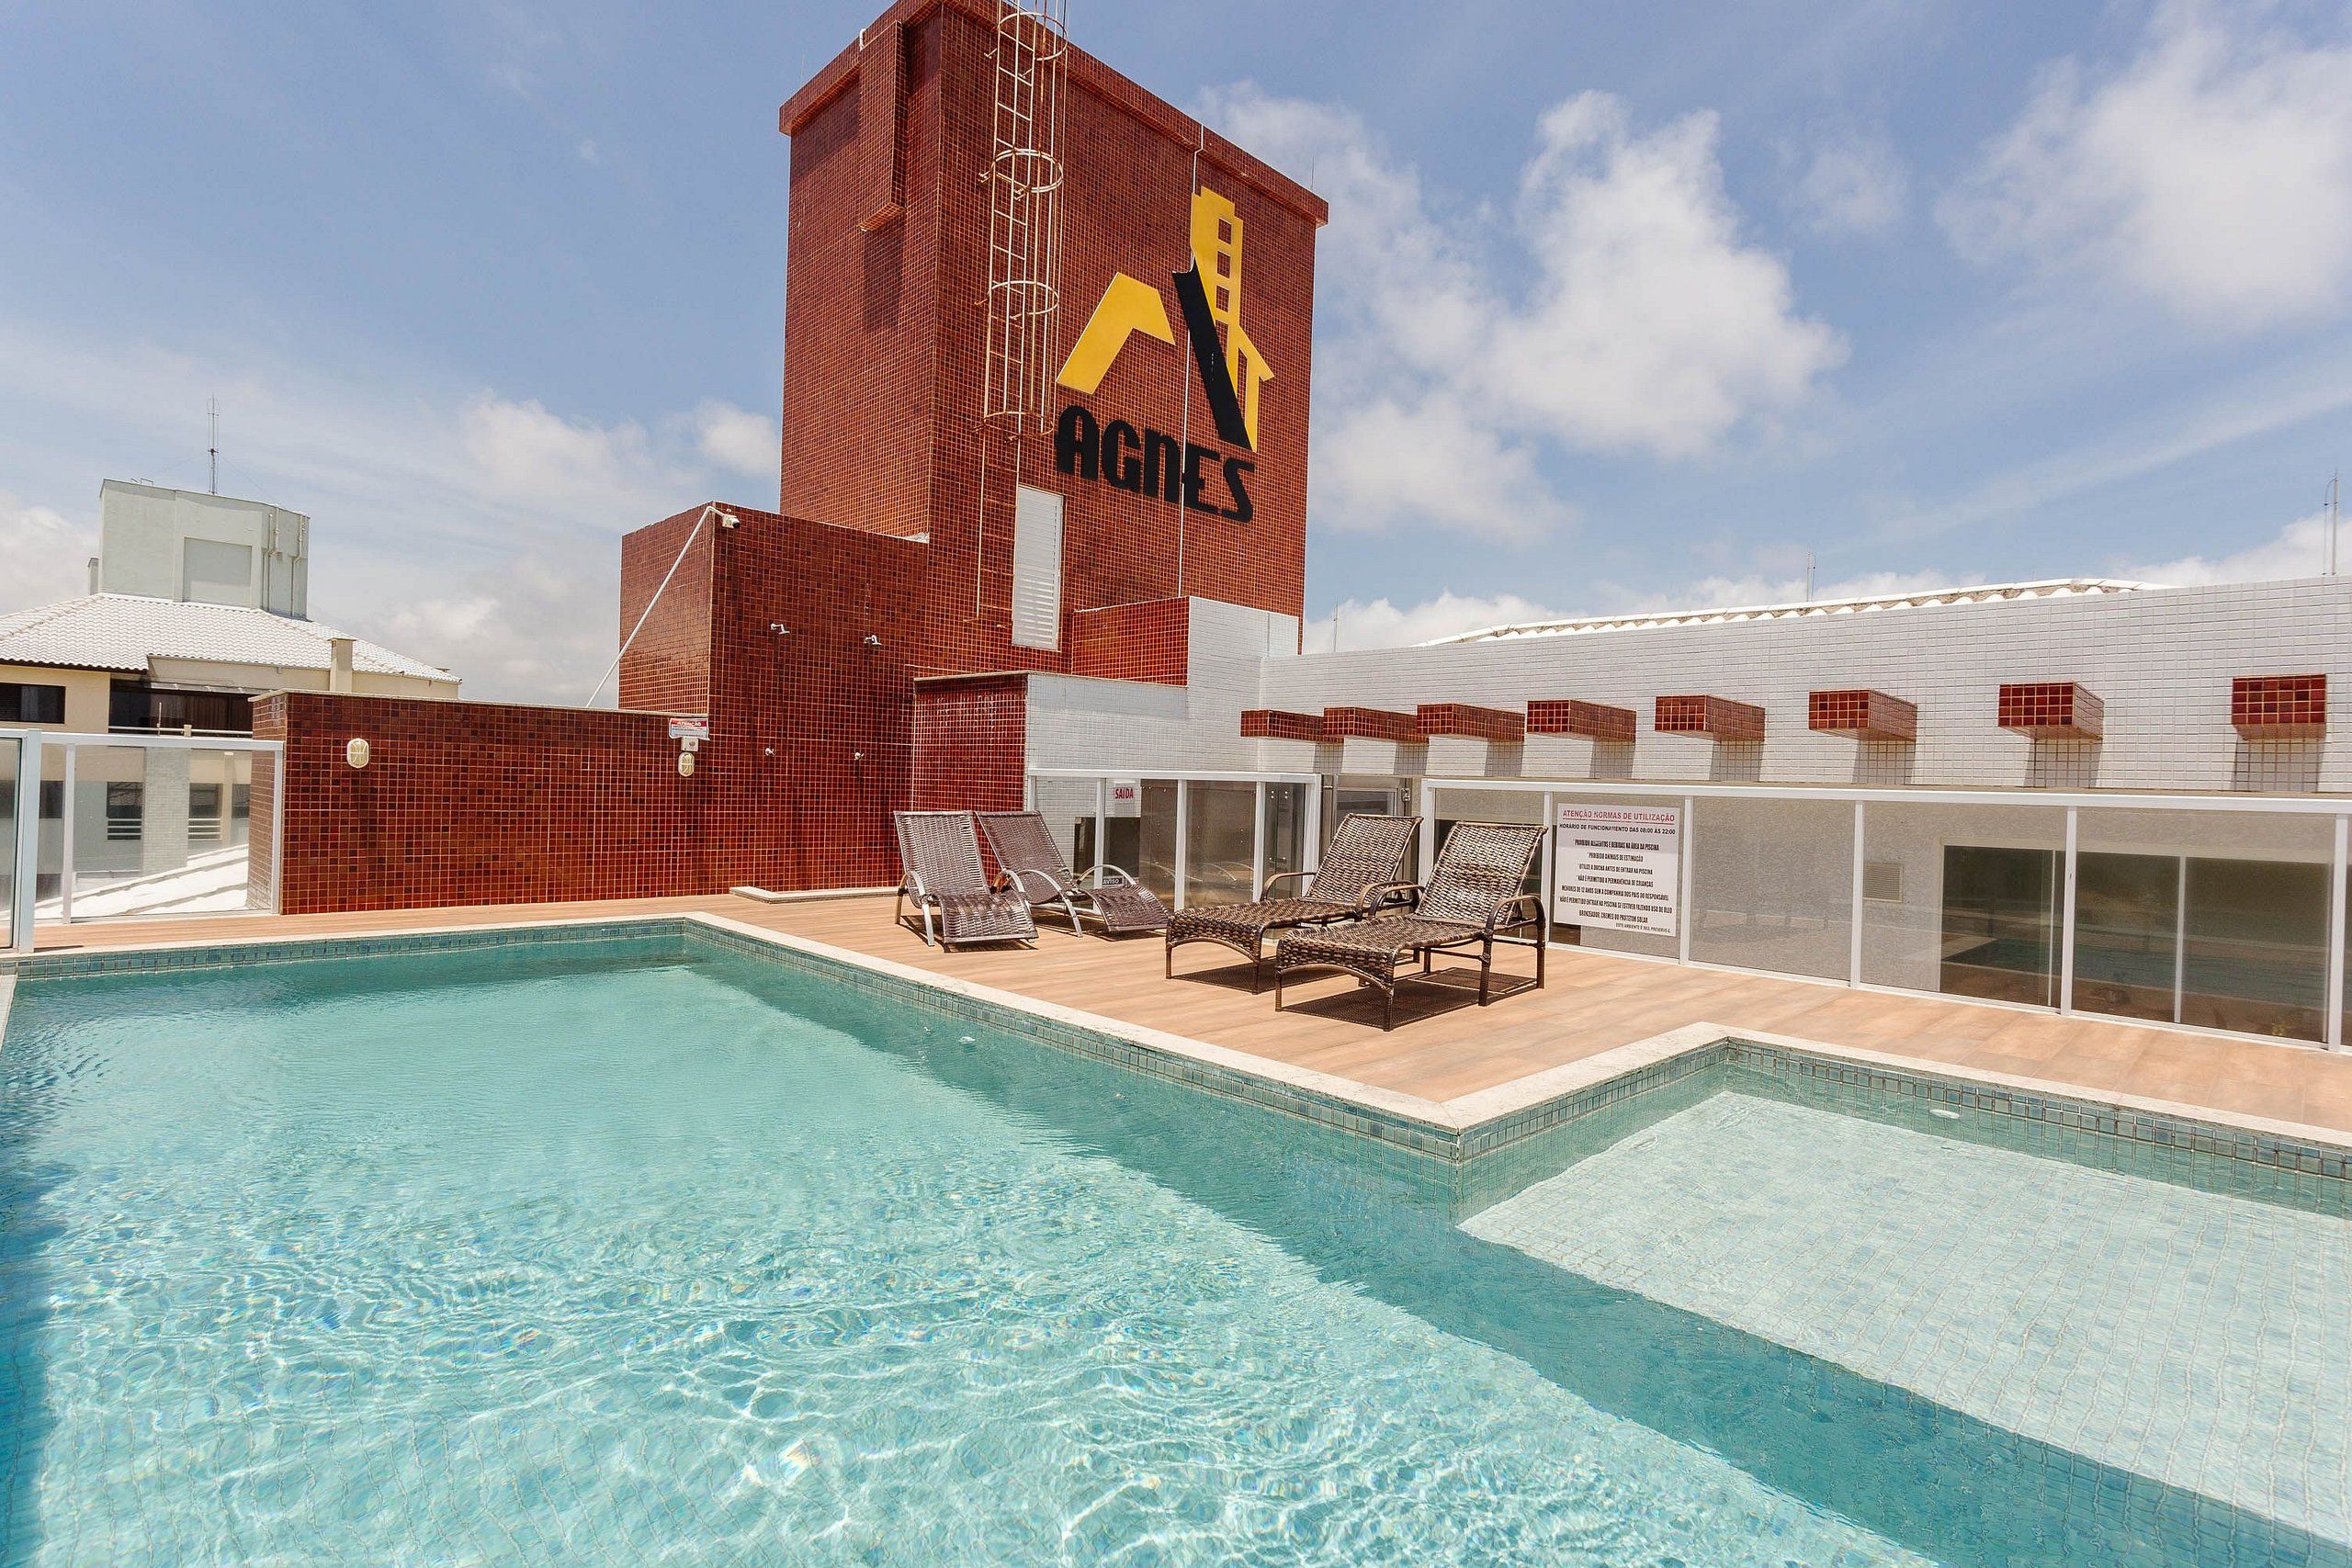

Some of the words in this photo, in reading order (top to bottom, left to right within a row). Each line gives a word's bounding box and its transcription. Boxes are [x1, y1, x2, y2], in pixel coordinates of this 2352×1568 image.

[1054, 405, 1256, 523] AGNES
[1594, 810, 1622, 818] NORMAS
[1634, 811, 1675, 823] UTILIZAÇÃO
